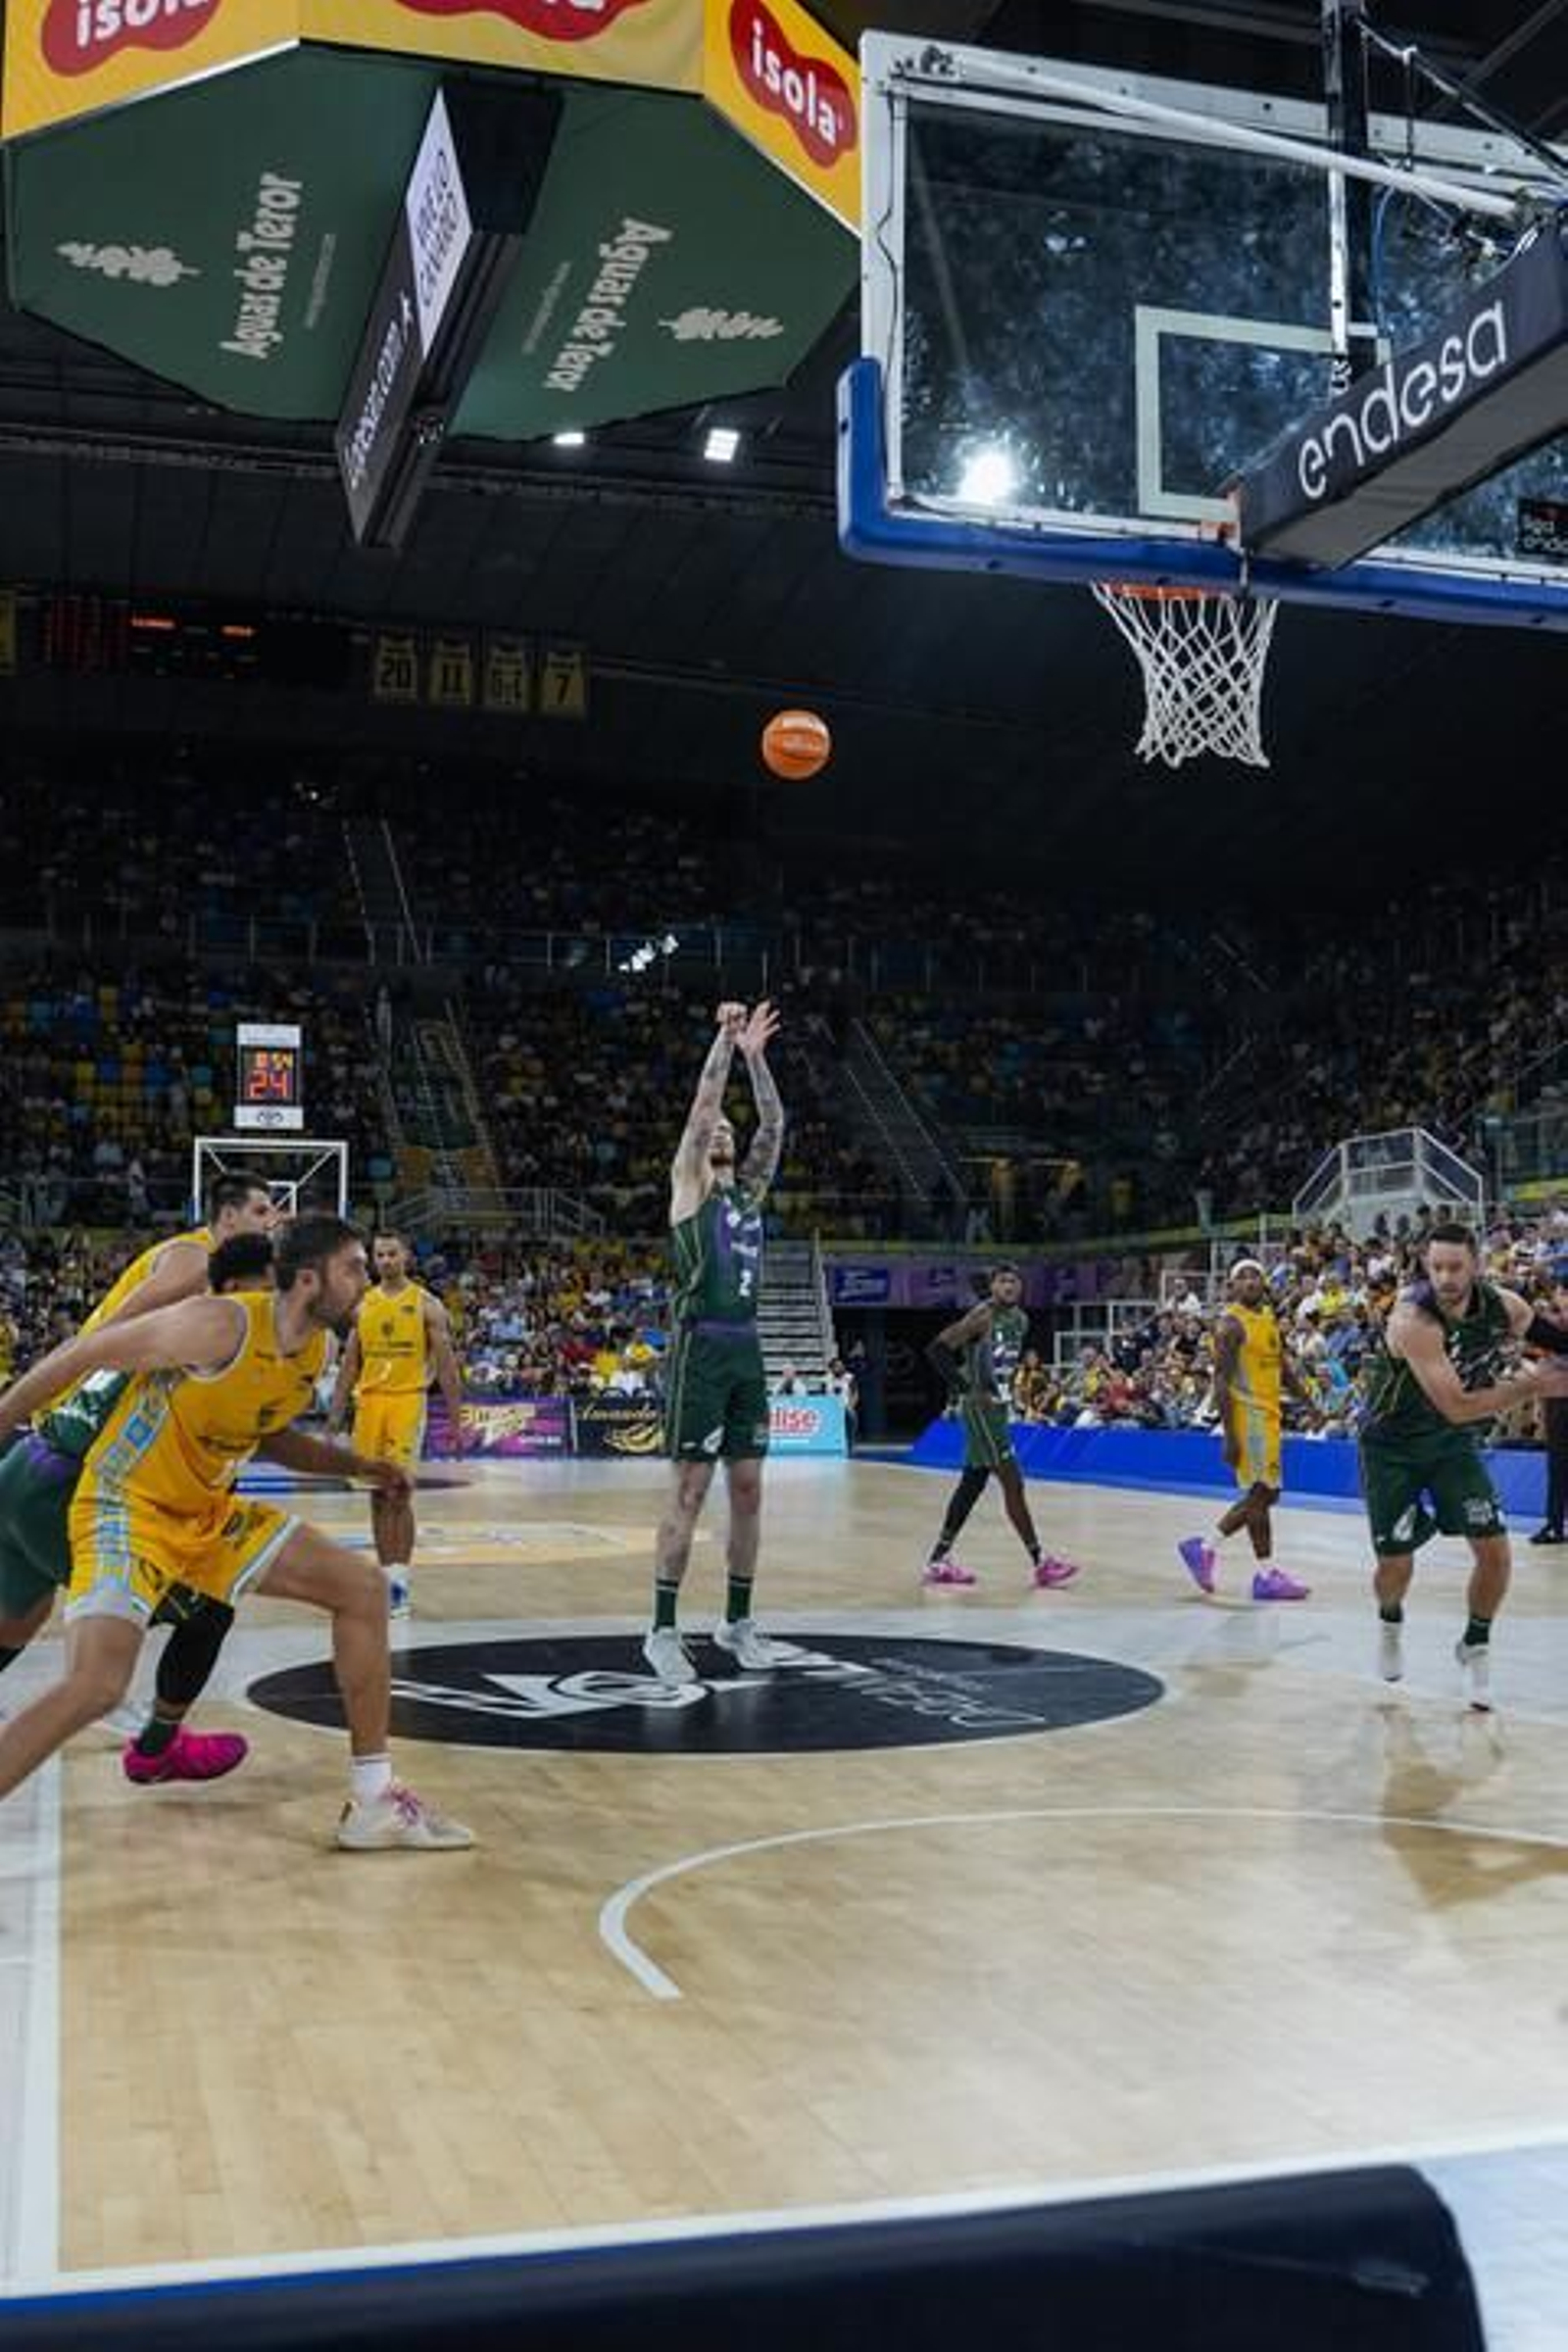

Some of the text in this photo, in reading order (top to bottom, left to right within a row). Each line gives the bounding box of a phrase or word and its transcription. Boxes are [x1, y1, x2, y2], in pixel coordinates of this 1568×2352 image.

[75, 0, 209, 47] iso
[753, 18, 836, 146] isola
[219, 172, 303, 360] Aguas de Teror
[587, 218, 673, 308] Aguas
[572, 307, 627, 340] de
[542, 342, 615, 392] Teror
[1298, 299, 1506, 499] endesa
[380, 657, 412, 689] 20
[555, 674, 573, 706] 7
[248, 1069, 287, 1099] 24
